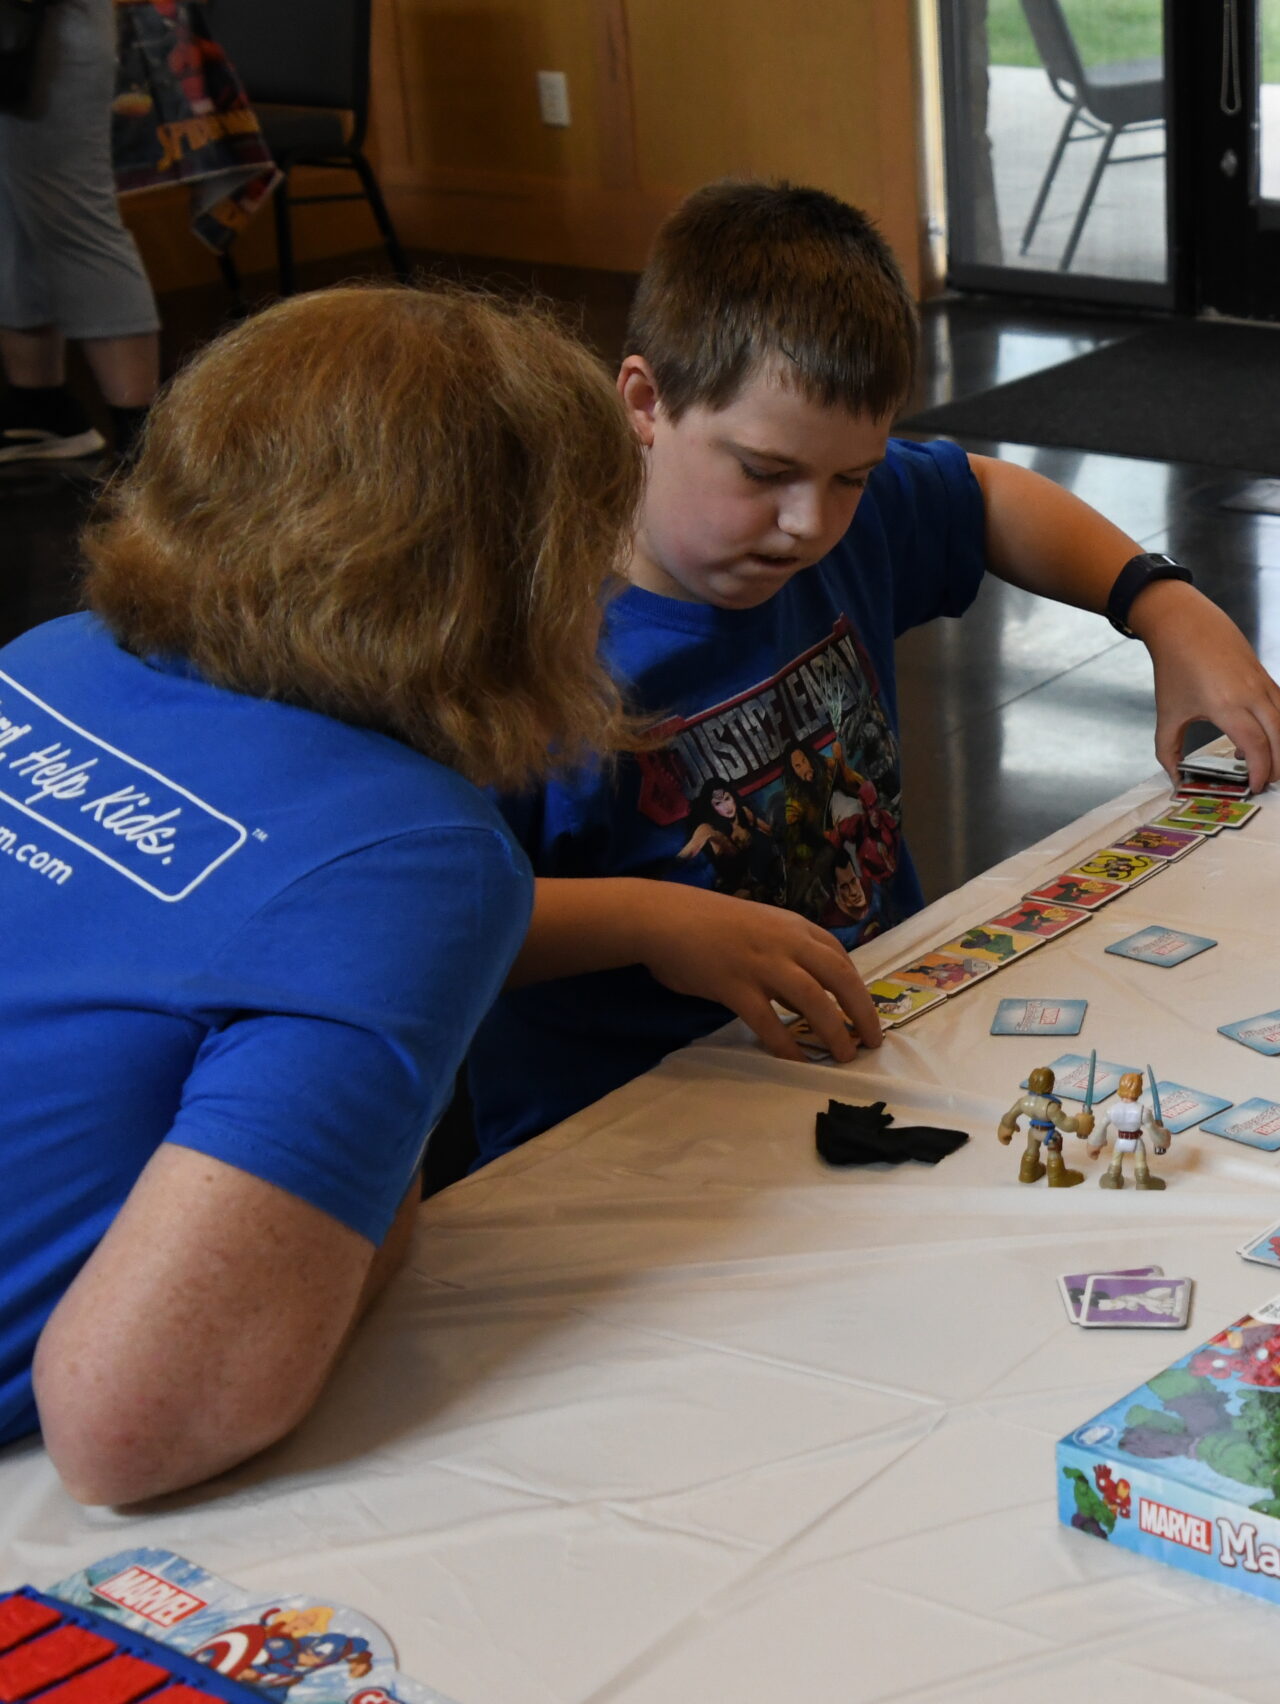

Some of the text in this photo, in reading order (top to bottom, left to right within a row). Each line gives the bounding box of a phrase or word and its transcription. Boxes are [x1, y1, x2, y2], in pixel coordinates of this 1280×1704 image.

[8, 742, 99, 806] Help
[80, 784, 182, 866] Kids.
[1140, 1499, 1212, 1554] MARVEL
[94, 1567, 205, 1627] MARVEL
